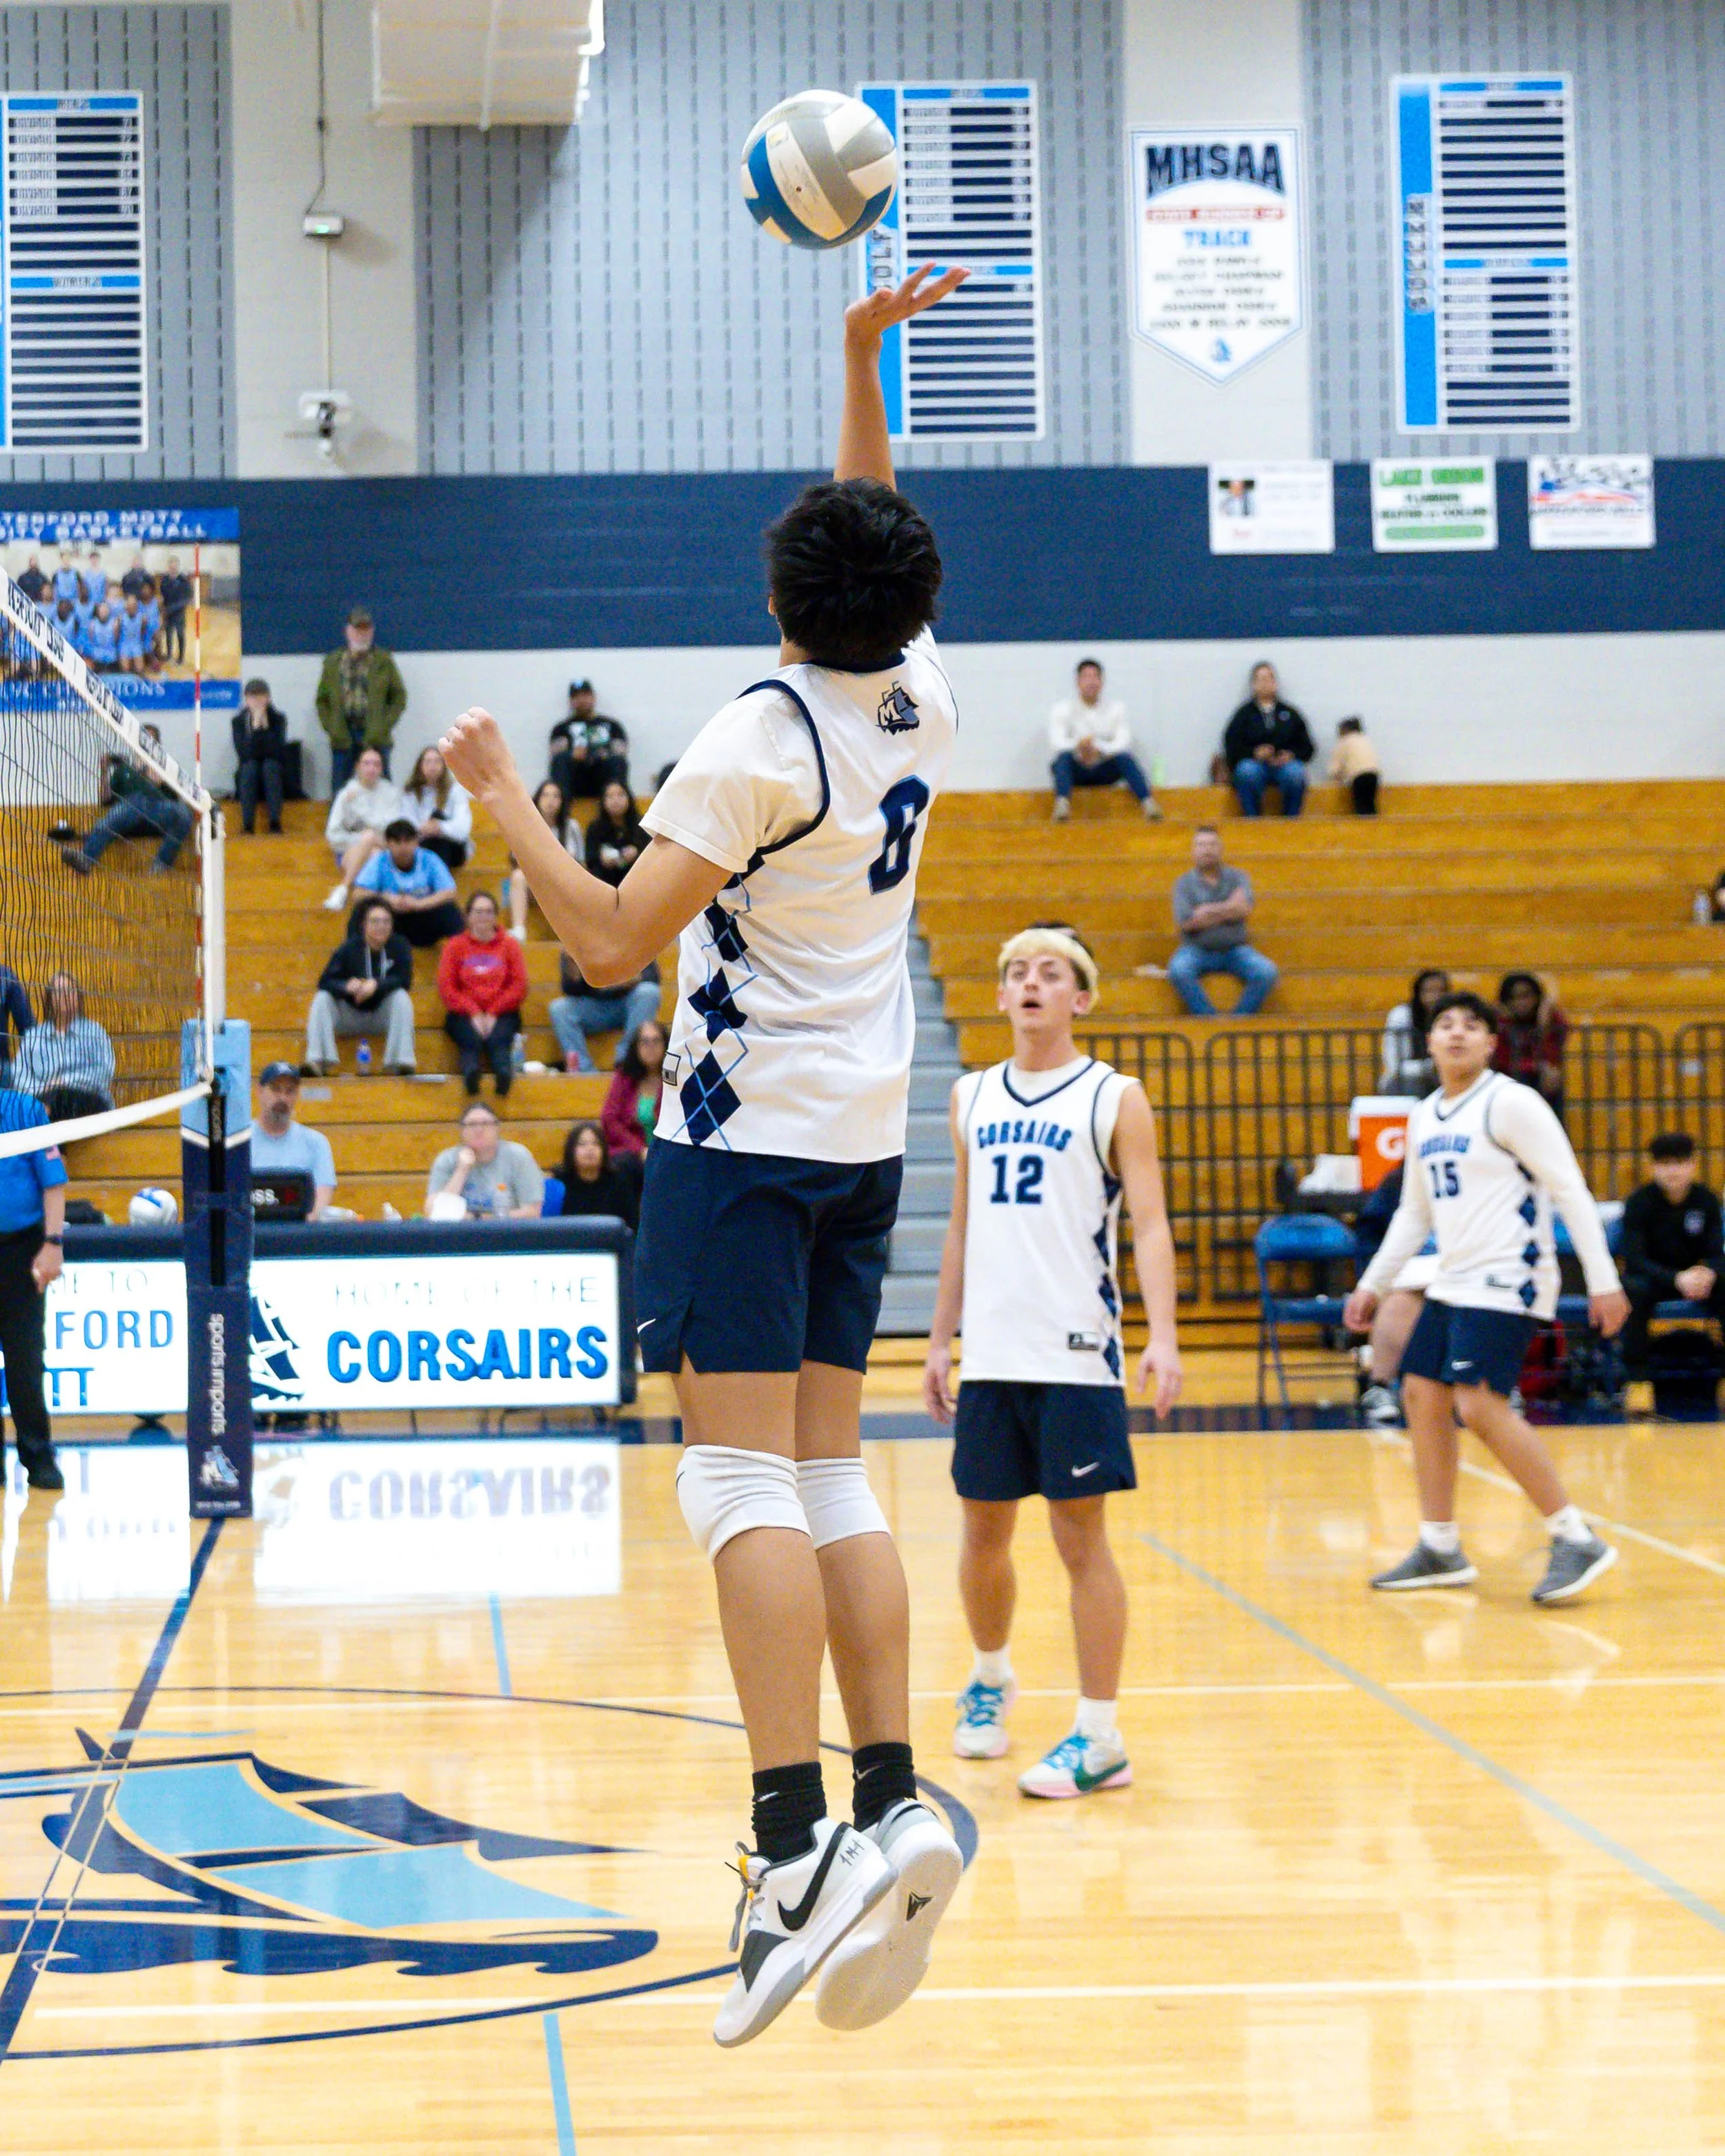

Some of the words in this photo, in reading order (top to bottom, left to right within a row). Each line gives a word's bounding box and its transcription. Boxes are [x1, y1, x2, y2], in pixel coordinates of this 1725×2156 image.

[1145, 142, 1285, 199] MHSAA
[868, 774, 930, 896] 6
[977, 1120, 1074, 1152] CORSAIRS
[989, 1154, 1044, 1204] 12
[1429, 1160, 1461, 1199] 15
[327, 1327, 609, 1383] CORSAIRS
